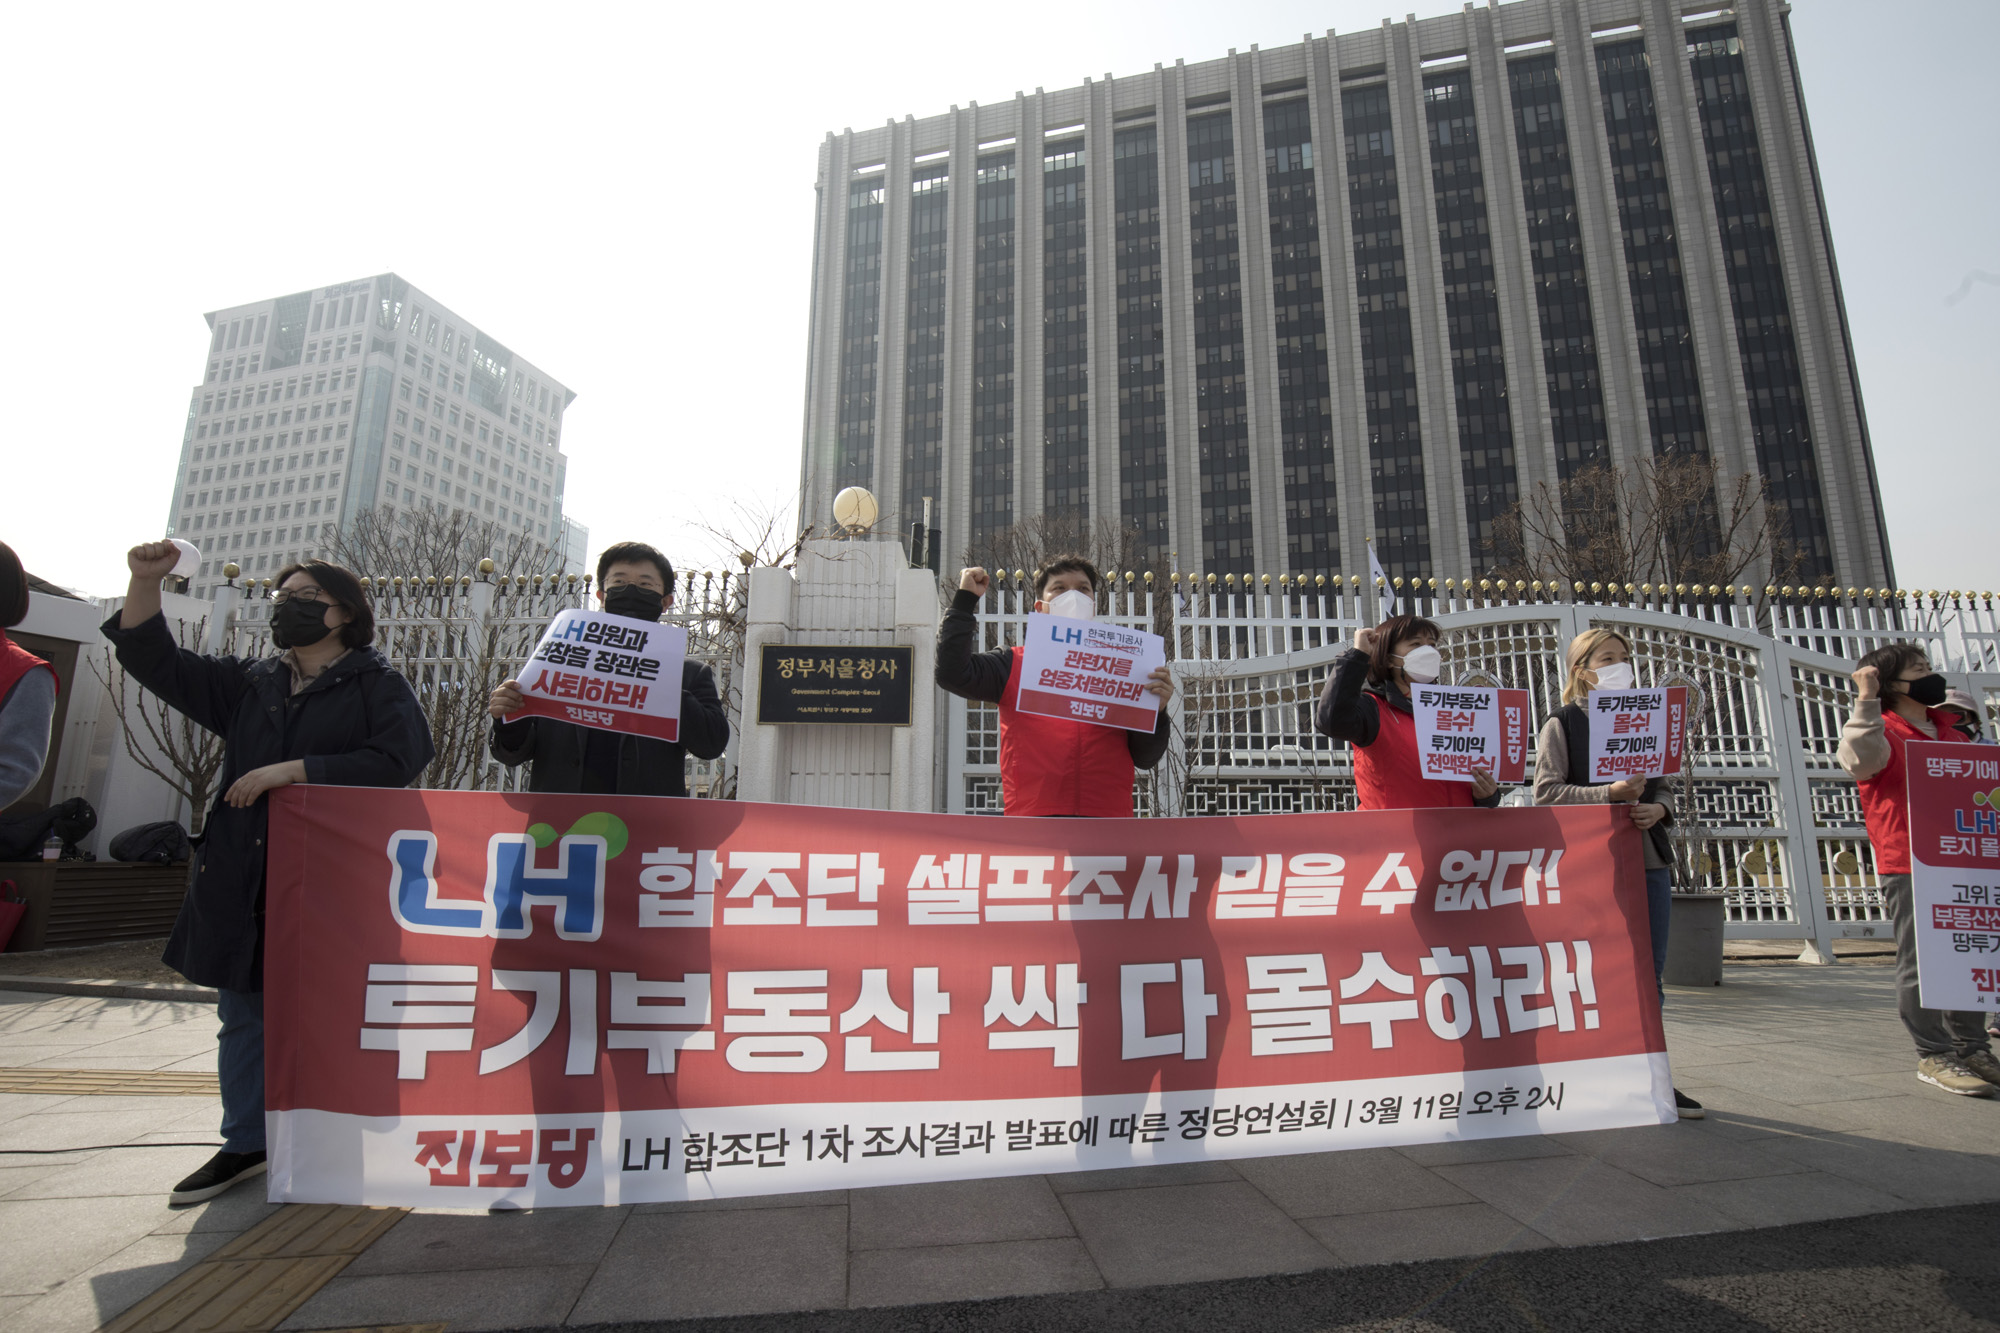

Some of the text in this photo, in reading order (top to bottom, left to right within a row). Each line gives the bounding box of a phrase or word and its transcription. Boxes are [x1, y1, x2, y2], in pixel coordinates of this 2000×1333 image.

[1051, 625, 1143, 647] LH 한국투기공사
[593, 649, 661, 681] 장관은
[777, 657, 898, 680] 정부서울청사
[1064, 650, 1133, 677] 관련자를
[531, 669, 649, 710] 사퇴하라!
[1038, 668, 1145, 702] 엄중처벌하라!
[1069, 701, 1108, 719] 진보당
[1419, 691, 1490, 710] 투기부동산
[1597, 694, 1662, 712] 투기부동산
[566, 706, 615, 726] 진보당
[1436, 710, 1475, 732] 몰수!
[1613, 712, 1650, 734] 몰수!
[1504, 706, 1522, 764] 진보당
[1670, 704, 1681, 758] 진보당
[1432, 734, 1486, 753] 투기이익
[1605, 736, 1657, 754] 투기이익
[1596, 753, 1663, 776] 전액환수!
[1926, 757, 1999, 780] 땅투기에
[1954, 808, 2000, 835] LH
[1939, 835, 2000, 858] 토지 몰
[387, 829, 1565, 941] LH 합조단 셀프조사 믿을 수 없다!
[1952, 884, 1989, 905] 고위
[1971, 968, 2000, 992] 진
[360, 939, 1602, 1080] 투기부동산 싹 다 몰수하라!
[622, 1137, 671, 1172] LH
[682, 1128, 790, 1174] 합조단
[802, 1121, 854, 1163] 1차
[861, 1120, 995, 1159] 조사결과
[1005, 1115, 1099, 1152] 발표에
[1109, 1111, 1170, 1145] 따른
[1177, 1098, 1337, 1141] 정당연설회
[1359, 1096, 1402, 1124] 3월
[1412, 1091, 1462, 1119] 11일
[1466, 1087, 1520, 1115] 오후
[1524, 1082, 1565, 1111] 2시
[414, 1127, 596, 1190] 진보당
